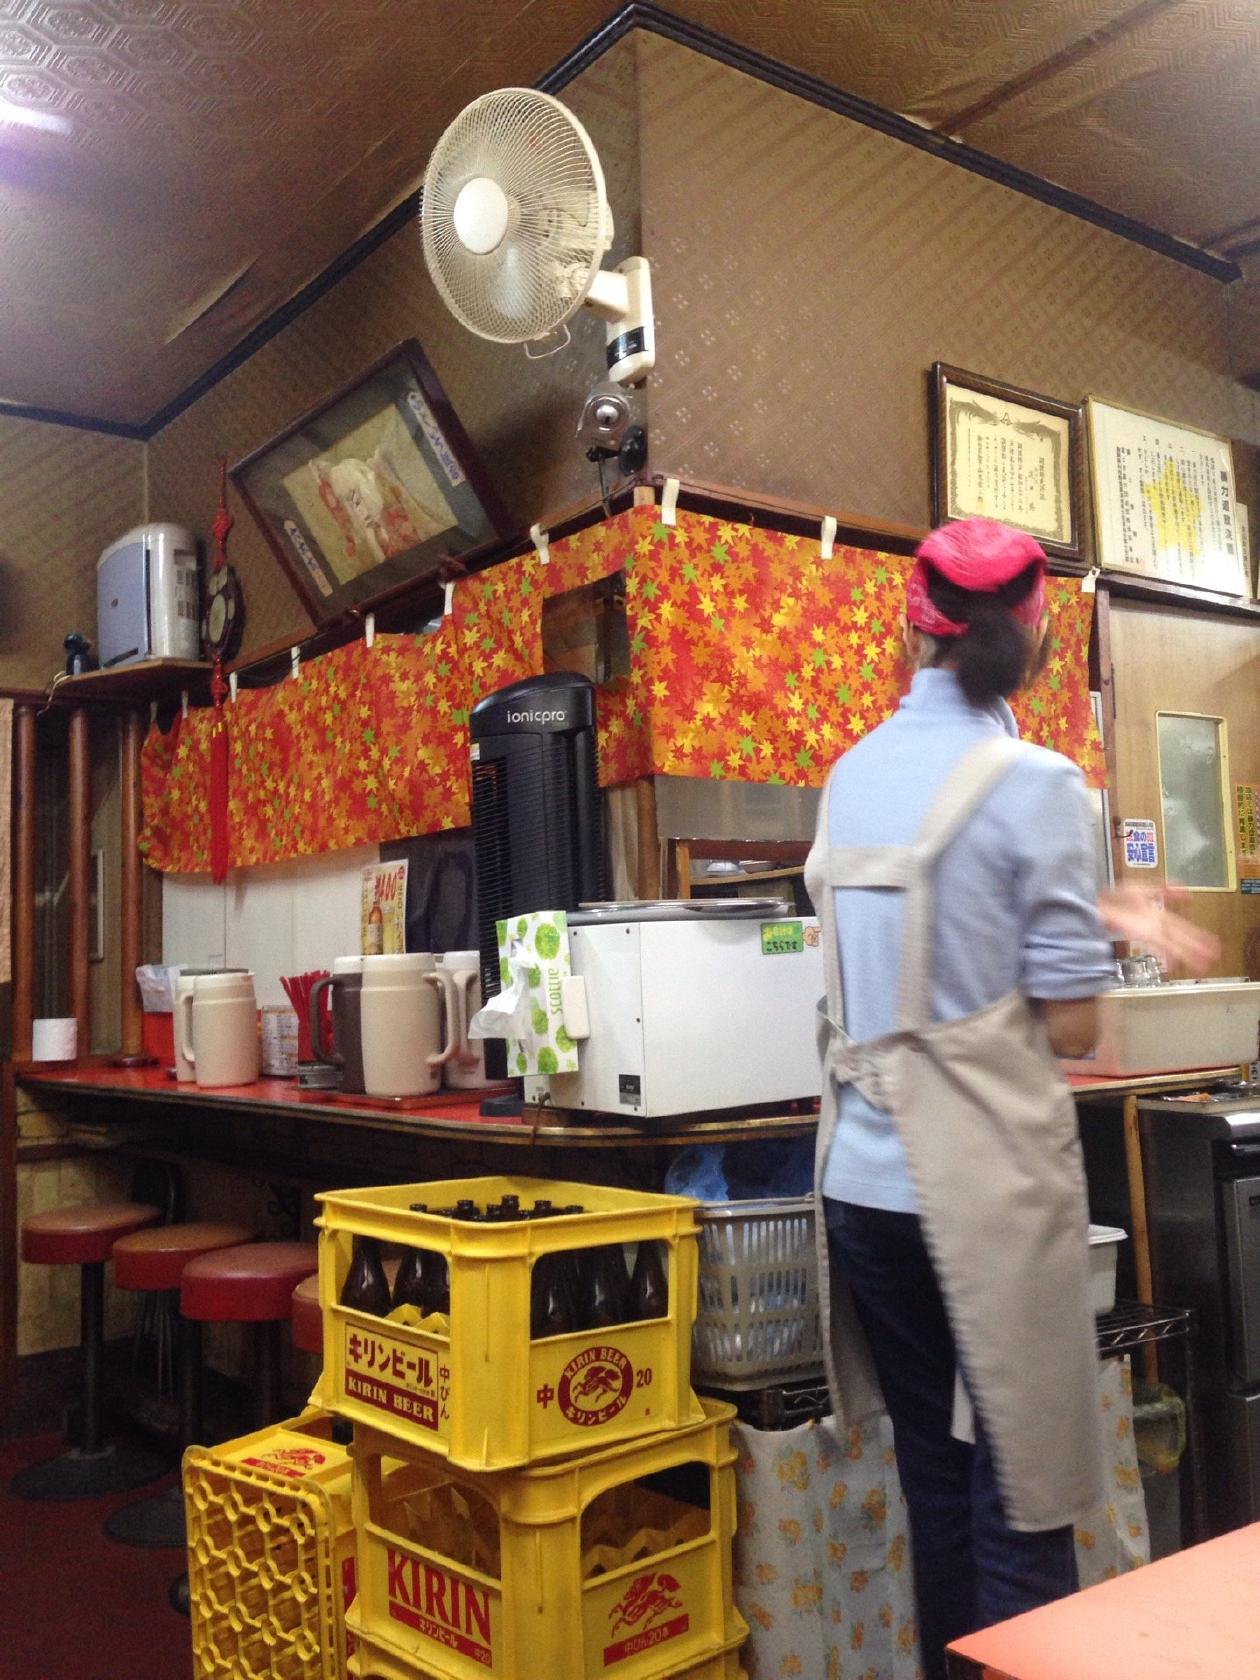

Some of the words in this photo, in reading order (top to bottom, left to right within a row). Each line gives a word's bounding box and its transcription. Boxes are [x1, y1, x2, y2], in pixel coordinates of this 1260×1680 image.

[507, 710, 565, 725] ionicpro
[349, 1333, 433, 1388] キリンビール
[564, 1350, 596, 1379] KIRIN
[600, 1348, 627, 1369] BEER
[440, 1363, 450, 1420] 中びん
[636, 1368, 652, 1388] 20
[348, 1376, 387, 1404] KIRIN
[393, 1393, 433, 1422] BEER
[536, 1384, 554, 1409] 中
[566, 1396, 627, 1425] キリンビール
[387, 1549, 491, 1645] KIRIN
[419, 1618, 458, 1648] キリンビール
